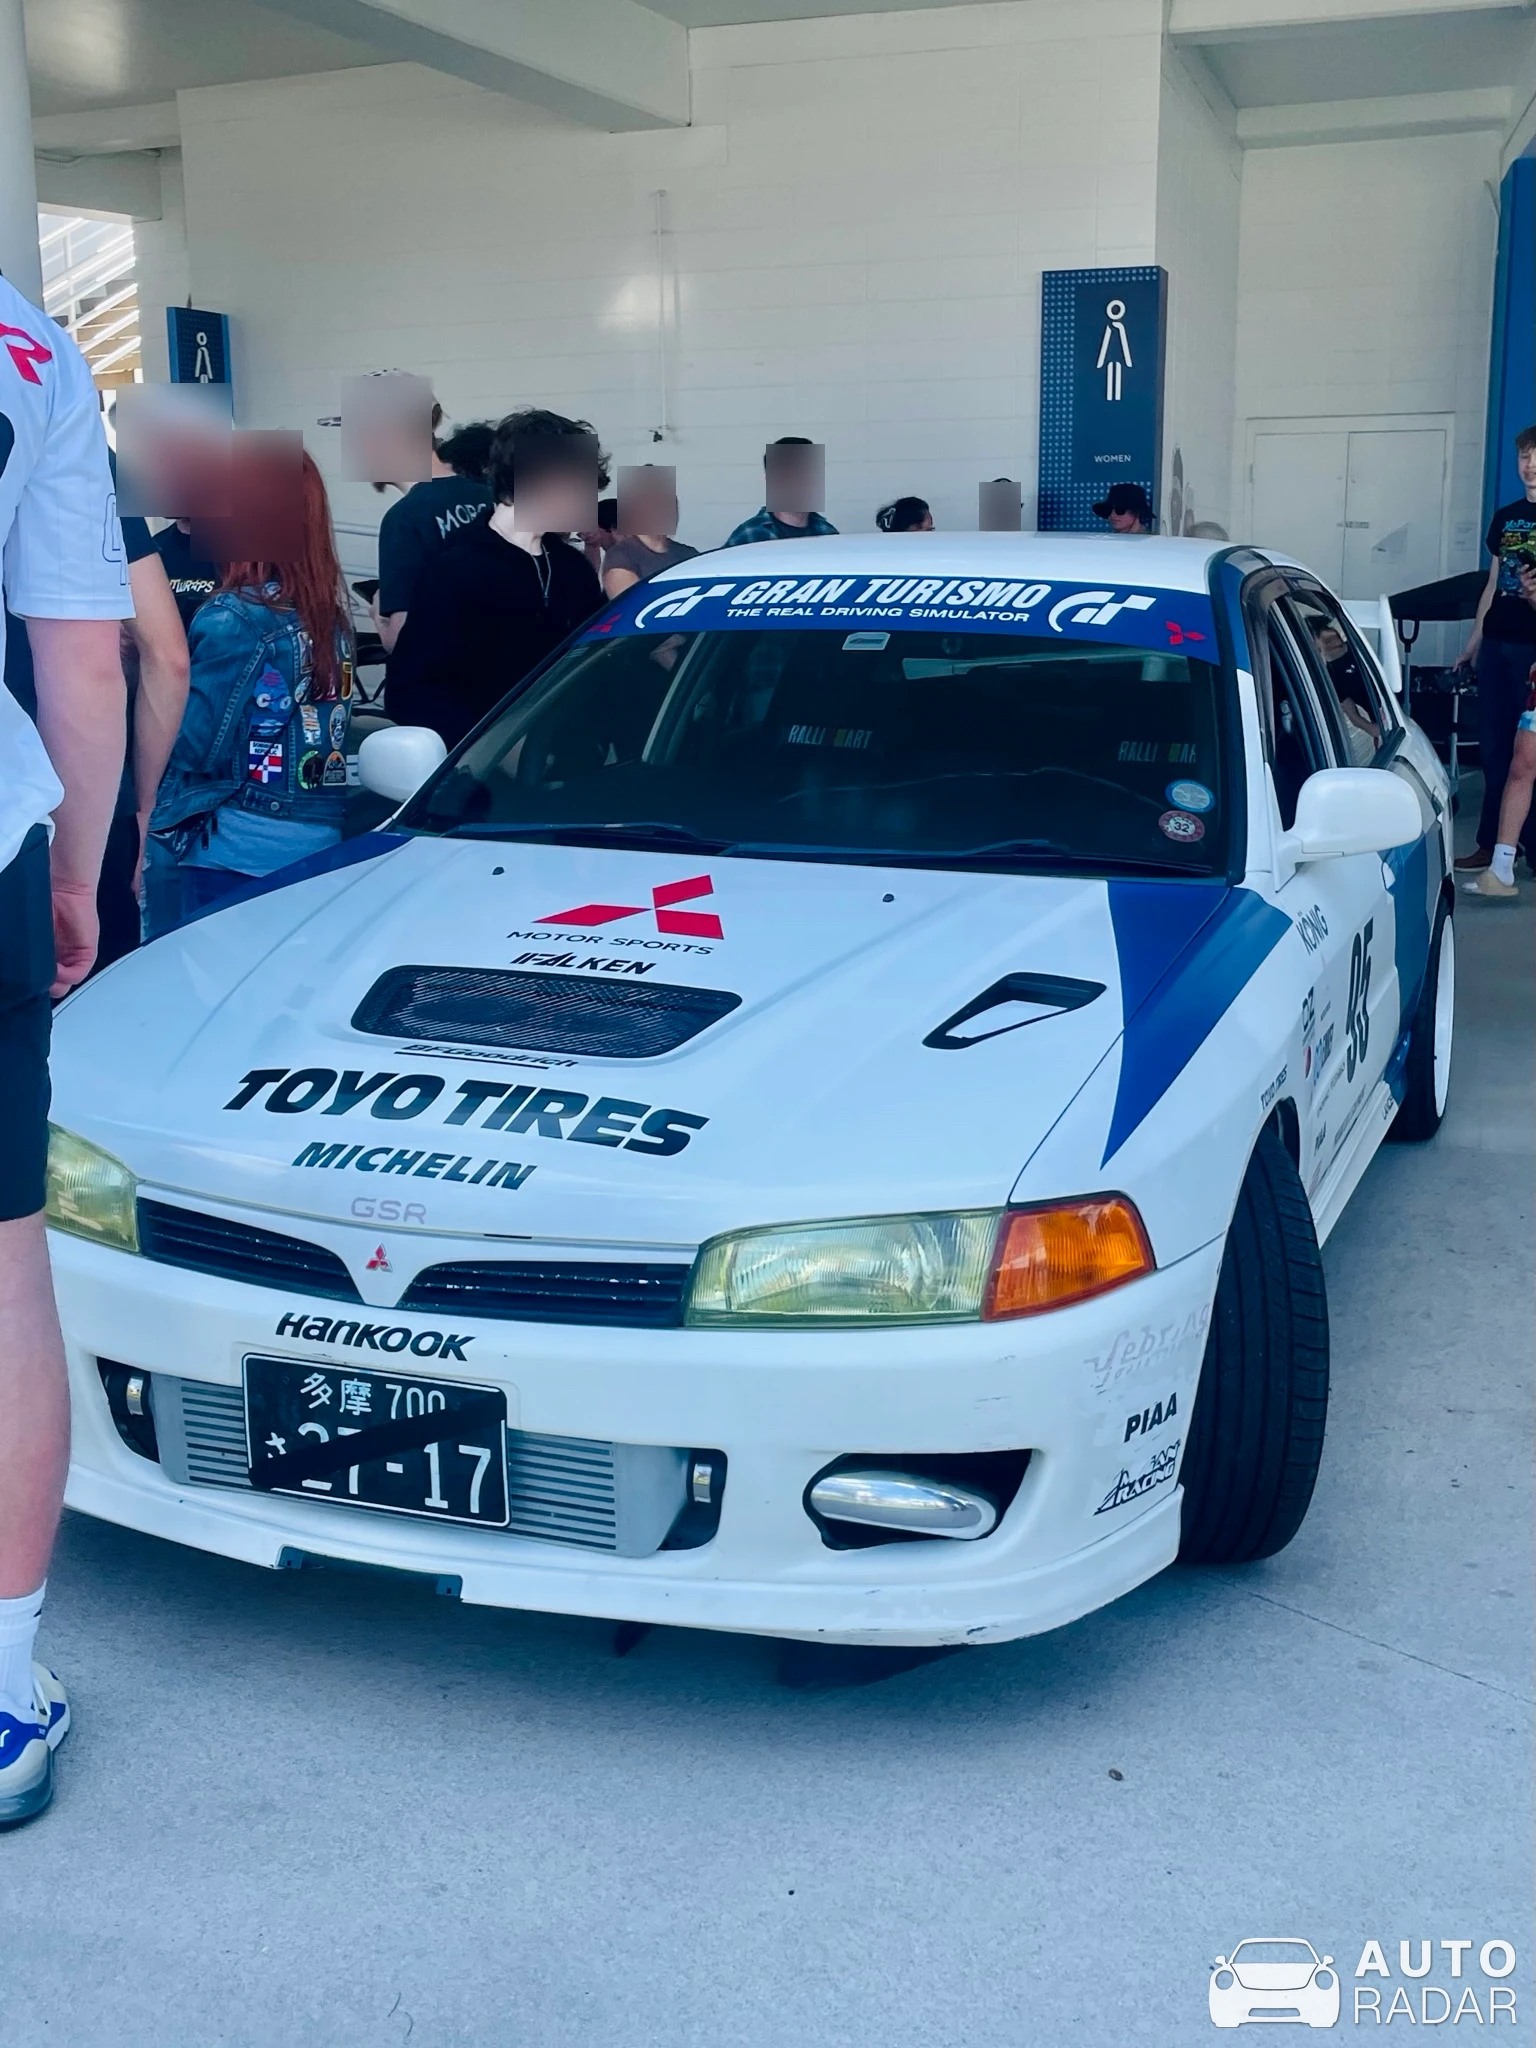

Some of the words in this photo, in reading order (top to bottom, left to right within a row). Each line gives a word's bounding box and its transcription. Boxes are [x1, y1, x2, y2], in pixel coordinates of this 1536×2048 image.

[1094, 454, 1132, 463] WOMEN
[730, 578, 856, 605] GRAN
[853, 577, 1052, 609] TURISMO
[726, 607, 761, 617] THE
[766, 607, 814, 617] REAL
[819, 607, 902, 618] DRIVING
[908, 608, 1029, 623] SIMULATOR
[1174, 820, 1190, 834] 32
[506, 930, 604, 945] MOTOR
[608, 936, 715, 956] SPORTS
[509, 951, 657, 975] FALKEN
[402, 1043, 579, 1068] BFGoodrich
[222, 1068, 446, 1120] TOYO
[443, 1079, 711, 1157] TIRES
[291, 1141, 538, 1191] MICHELIN
[350, 1197, 427, 1225] GSR
[300, 1372, 372, 1416] 多摩
[1123, 1391, 1177, 1443] PIAA
[1115, 1460, 1176, 1507] RACING
